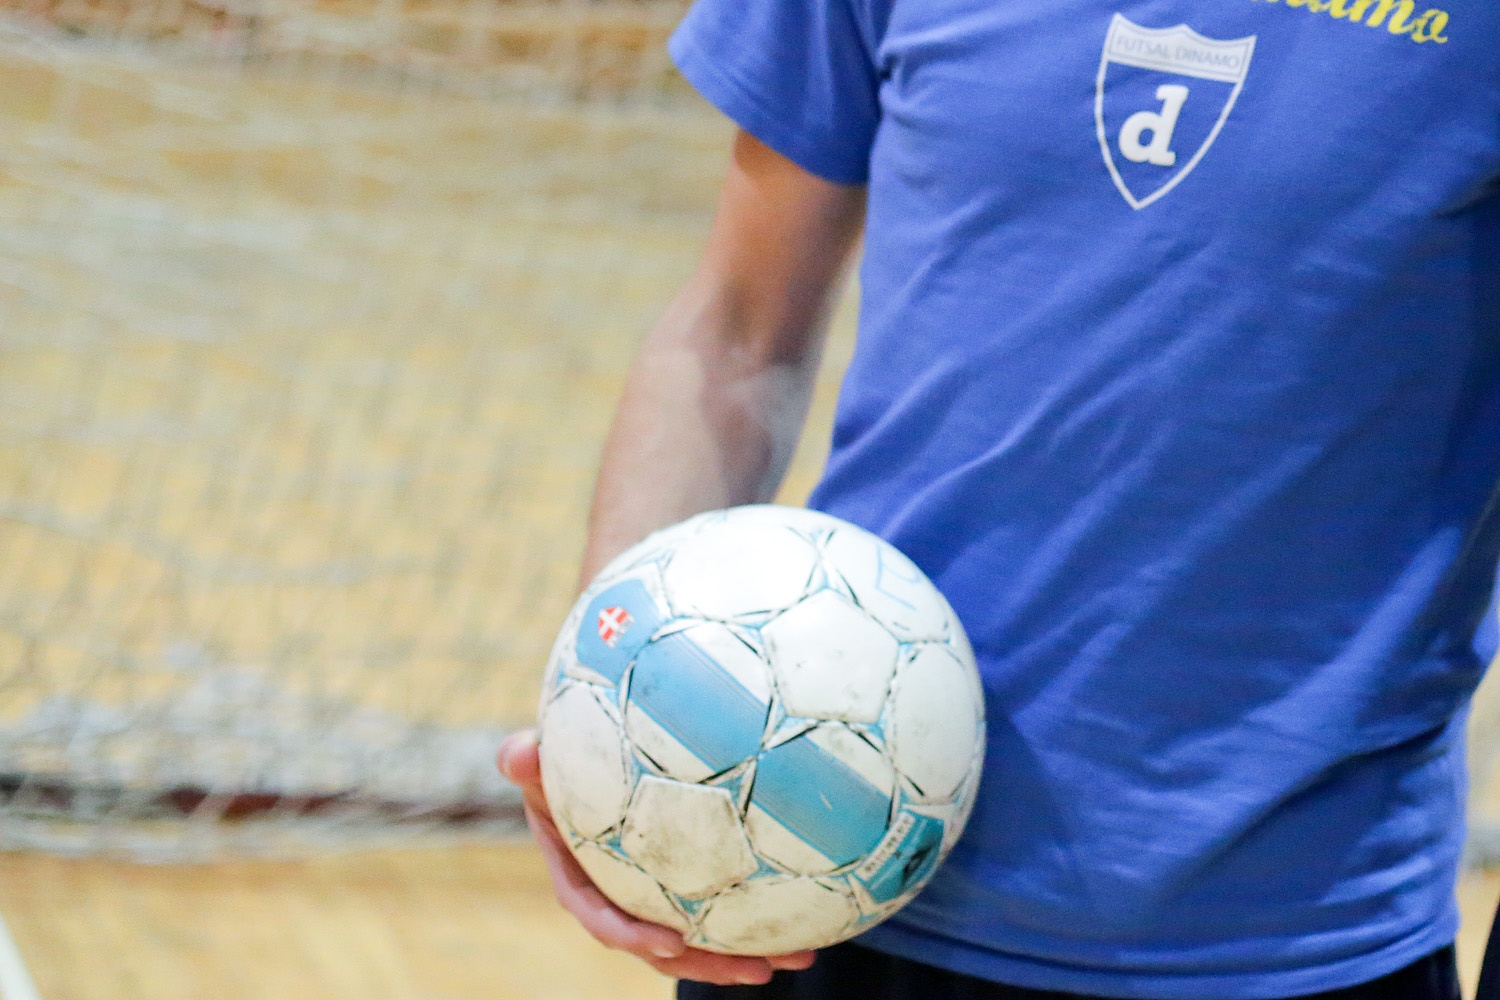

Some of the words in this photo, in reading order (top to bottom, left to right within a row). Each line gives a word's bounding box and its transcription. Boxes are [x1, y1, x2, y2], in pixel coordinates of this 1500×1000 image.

[1117, 34, 1169, 60] FUTSAL
[1175, 45, 1240, 69] DINAMO
[1118, 84, 1189, 166] d
